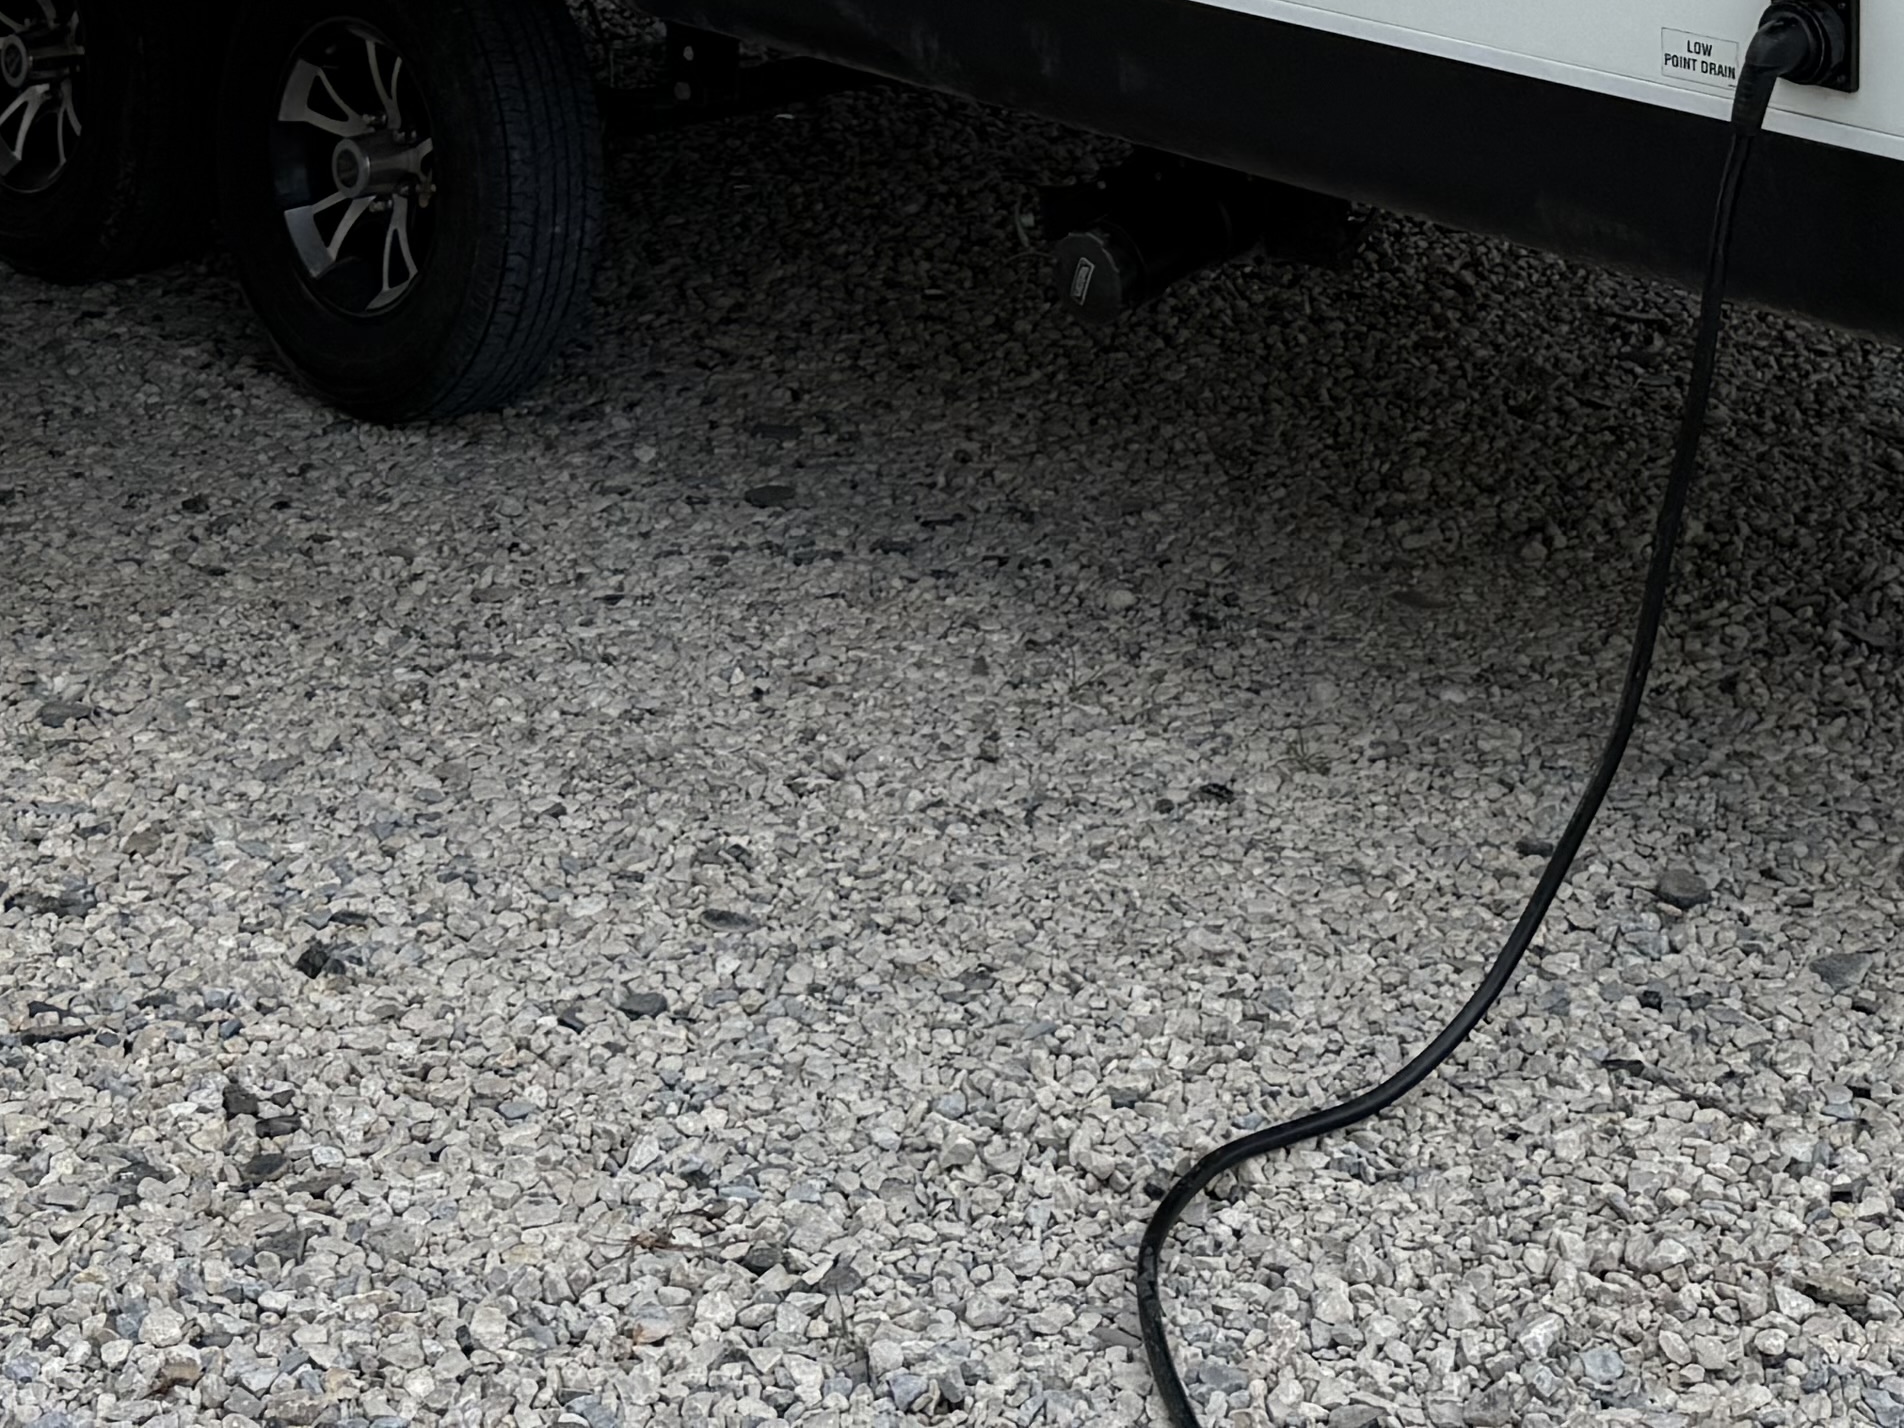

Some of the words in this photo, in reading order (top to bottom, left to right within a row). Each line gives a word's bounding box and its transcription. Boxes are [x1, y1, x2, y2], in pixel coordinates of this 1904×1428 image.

[1687, 40, 1713, 57] LOW
[1664, 53, 1697, 71] POINT
[1701, 60, 1736, 80] DRAIN
